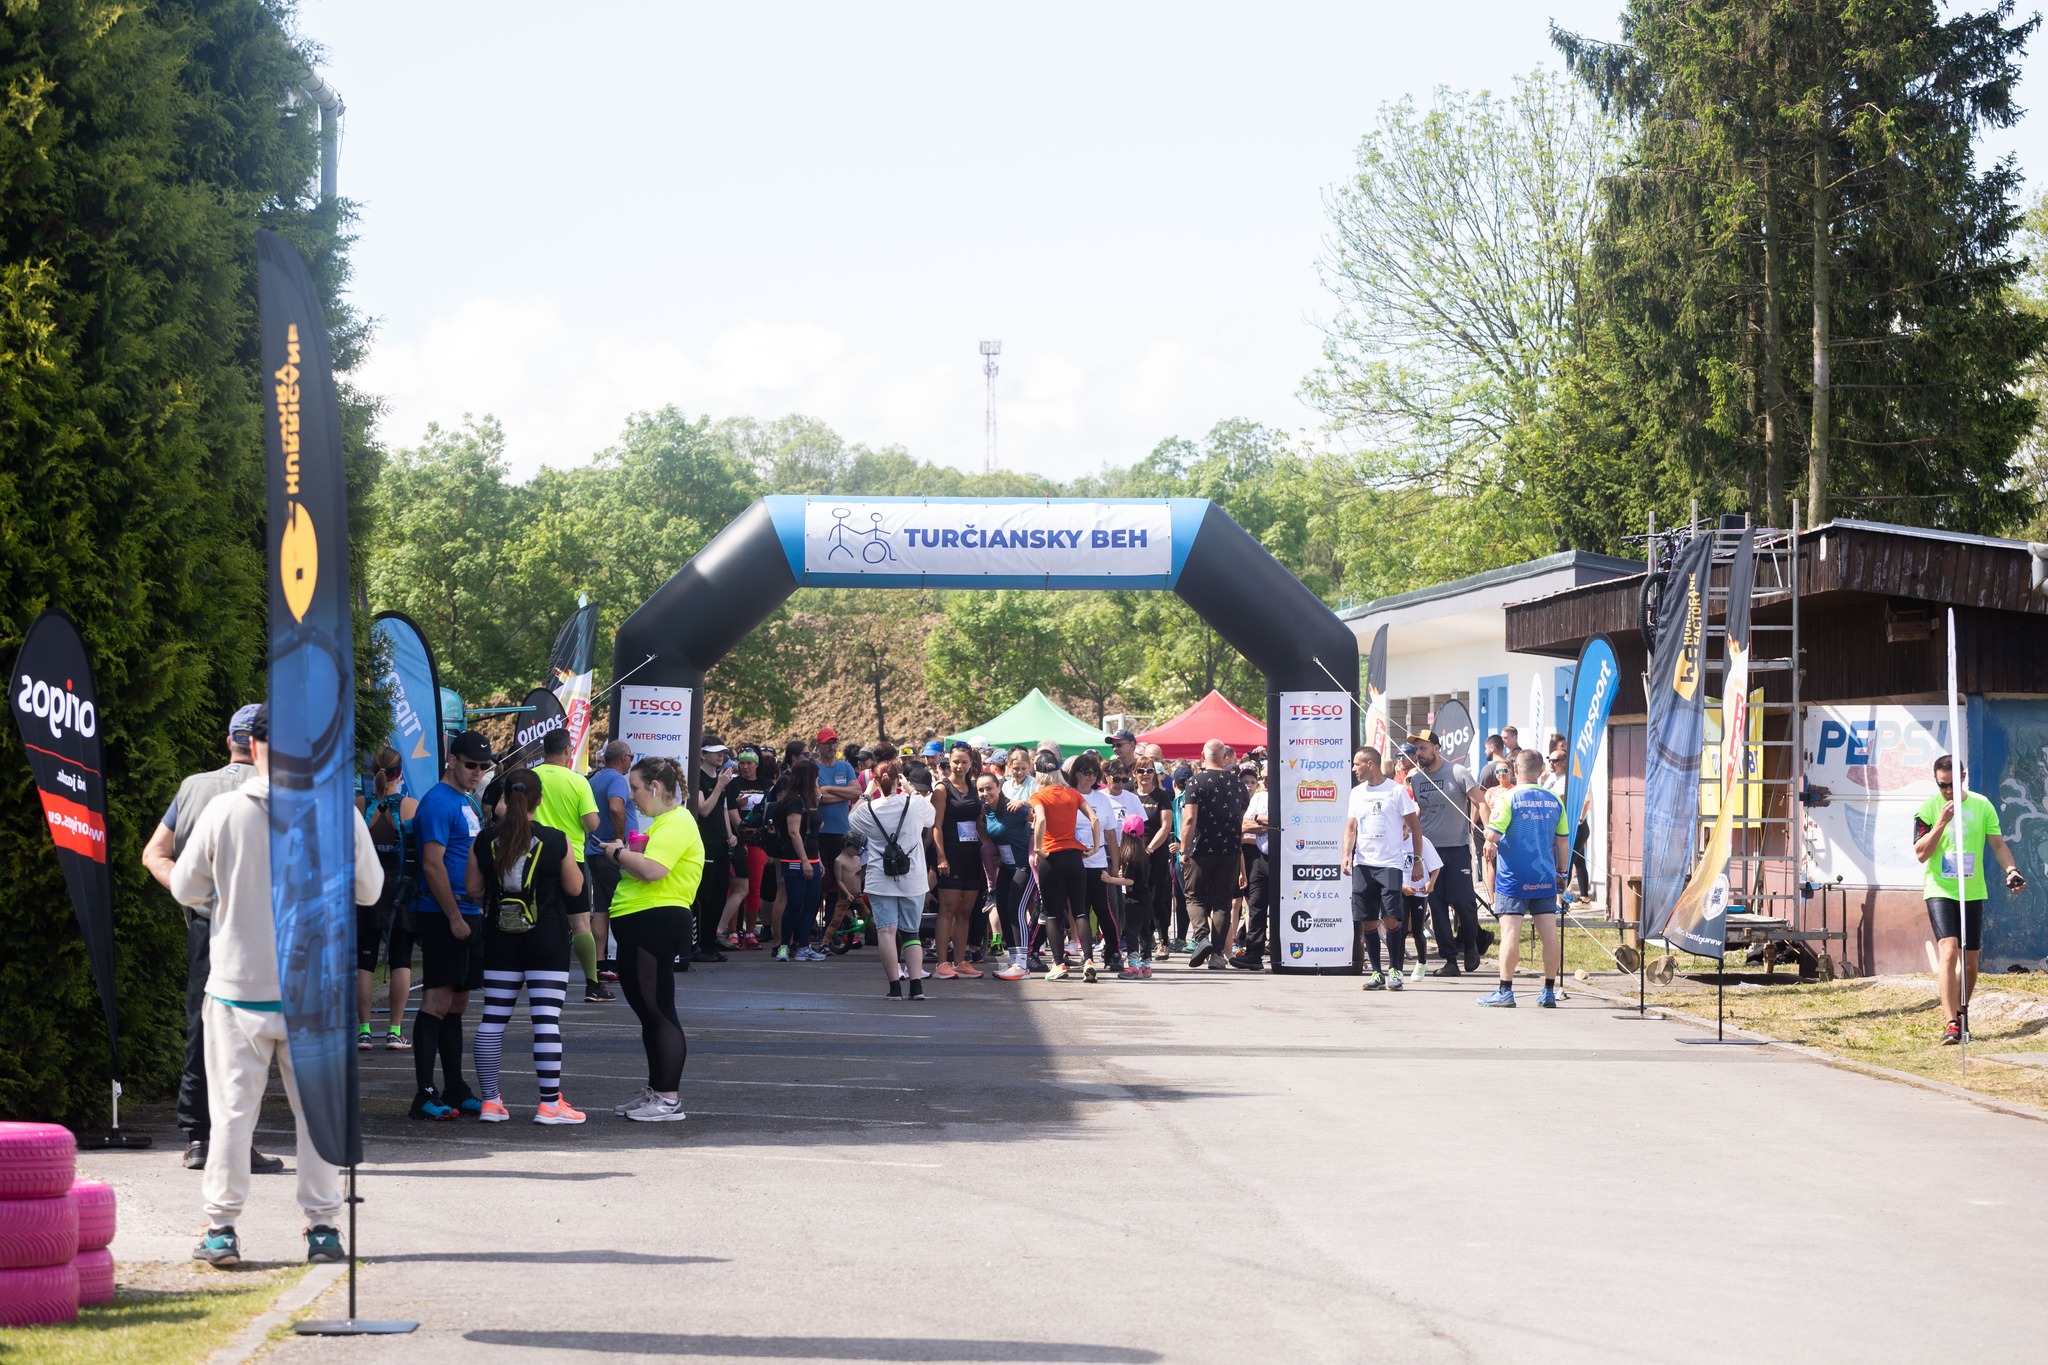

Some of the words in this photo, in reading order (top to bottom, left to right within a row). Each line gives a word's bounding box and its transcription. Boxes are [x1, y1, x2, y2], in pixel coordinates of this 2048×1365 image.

[904, 524, 1083, 549] TURČIANSKY
[1091, 529, 1148, 548] BEH
[1692, 591, 1702, 646] FACTORY
[629, 699, 683, 712] TESCO
[1289, 705, 1343, 716] TESCO
[1577, 659, 1612, 757] Tipsport
[517, 713, 563, 747] origos
[633, 732, 682, 742] INTERSPORT
[1295, 738, 1344, 746] INTERSPORT
[1438, 726, 1470, 755] rigos
[1816, 720, 1950, 765] PEPSI
[1299, 758, 1345, 772] Tipsport
[1300, 788, 1334, 799] Urpiner
[1296, 865, 1338, 880] origos
[1303, 891, 1340, 899] KOŠECA
